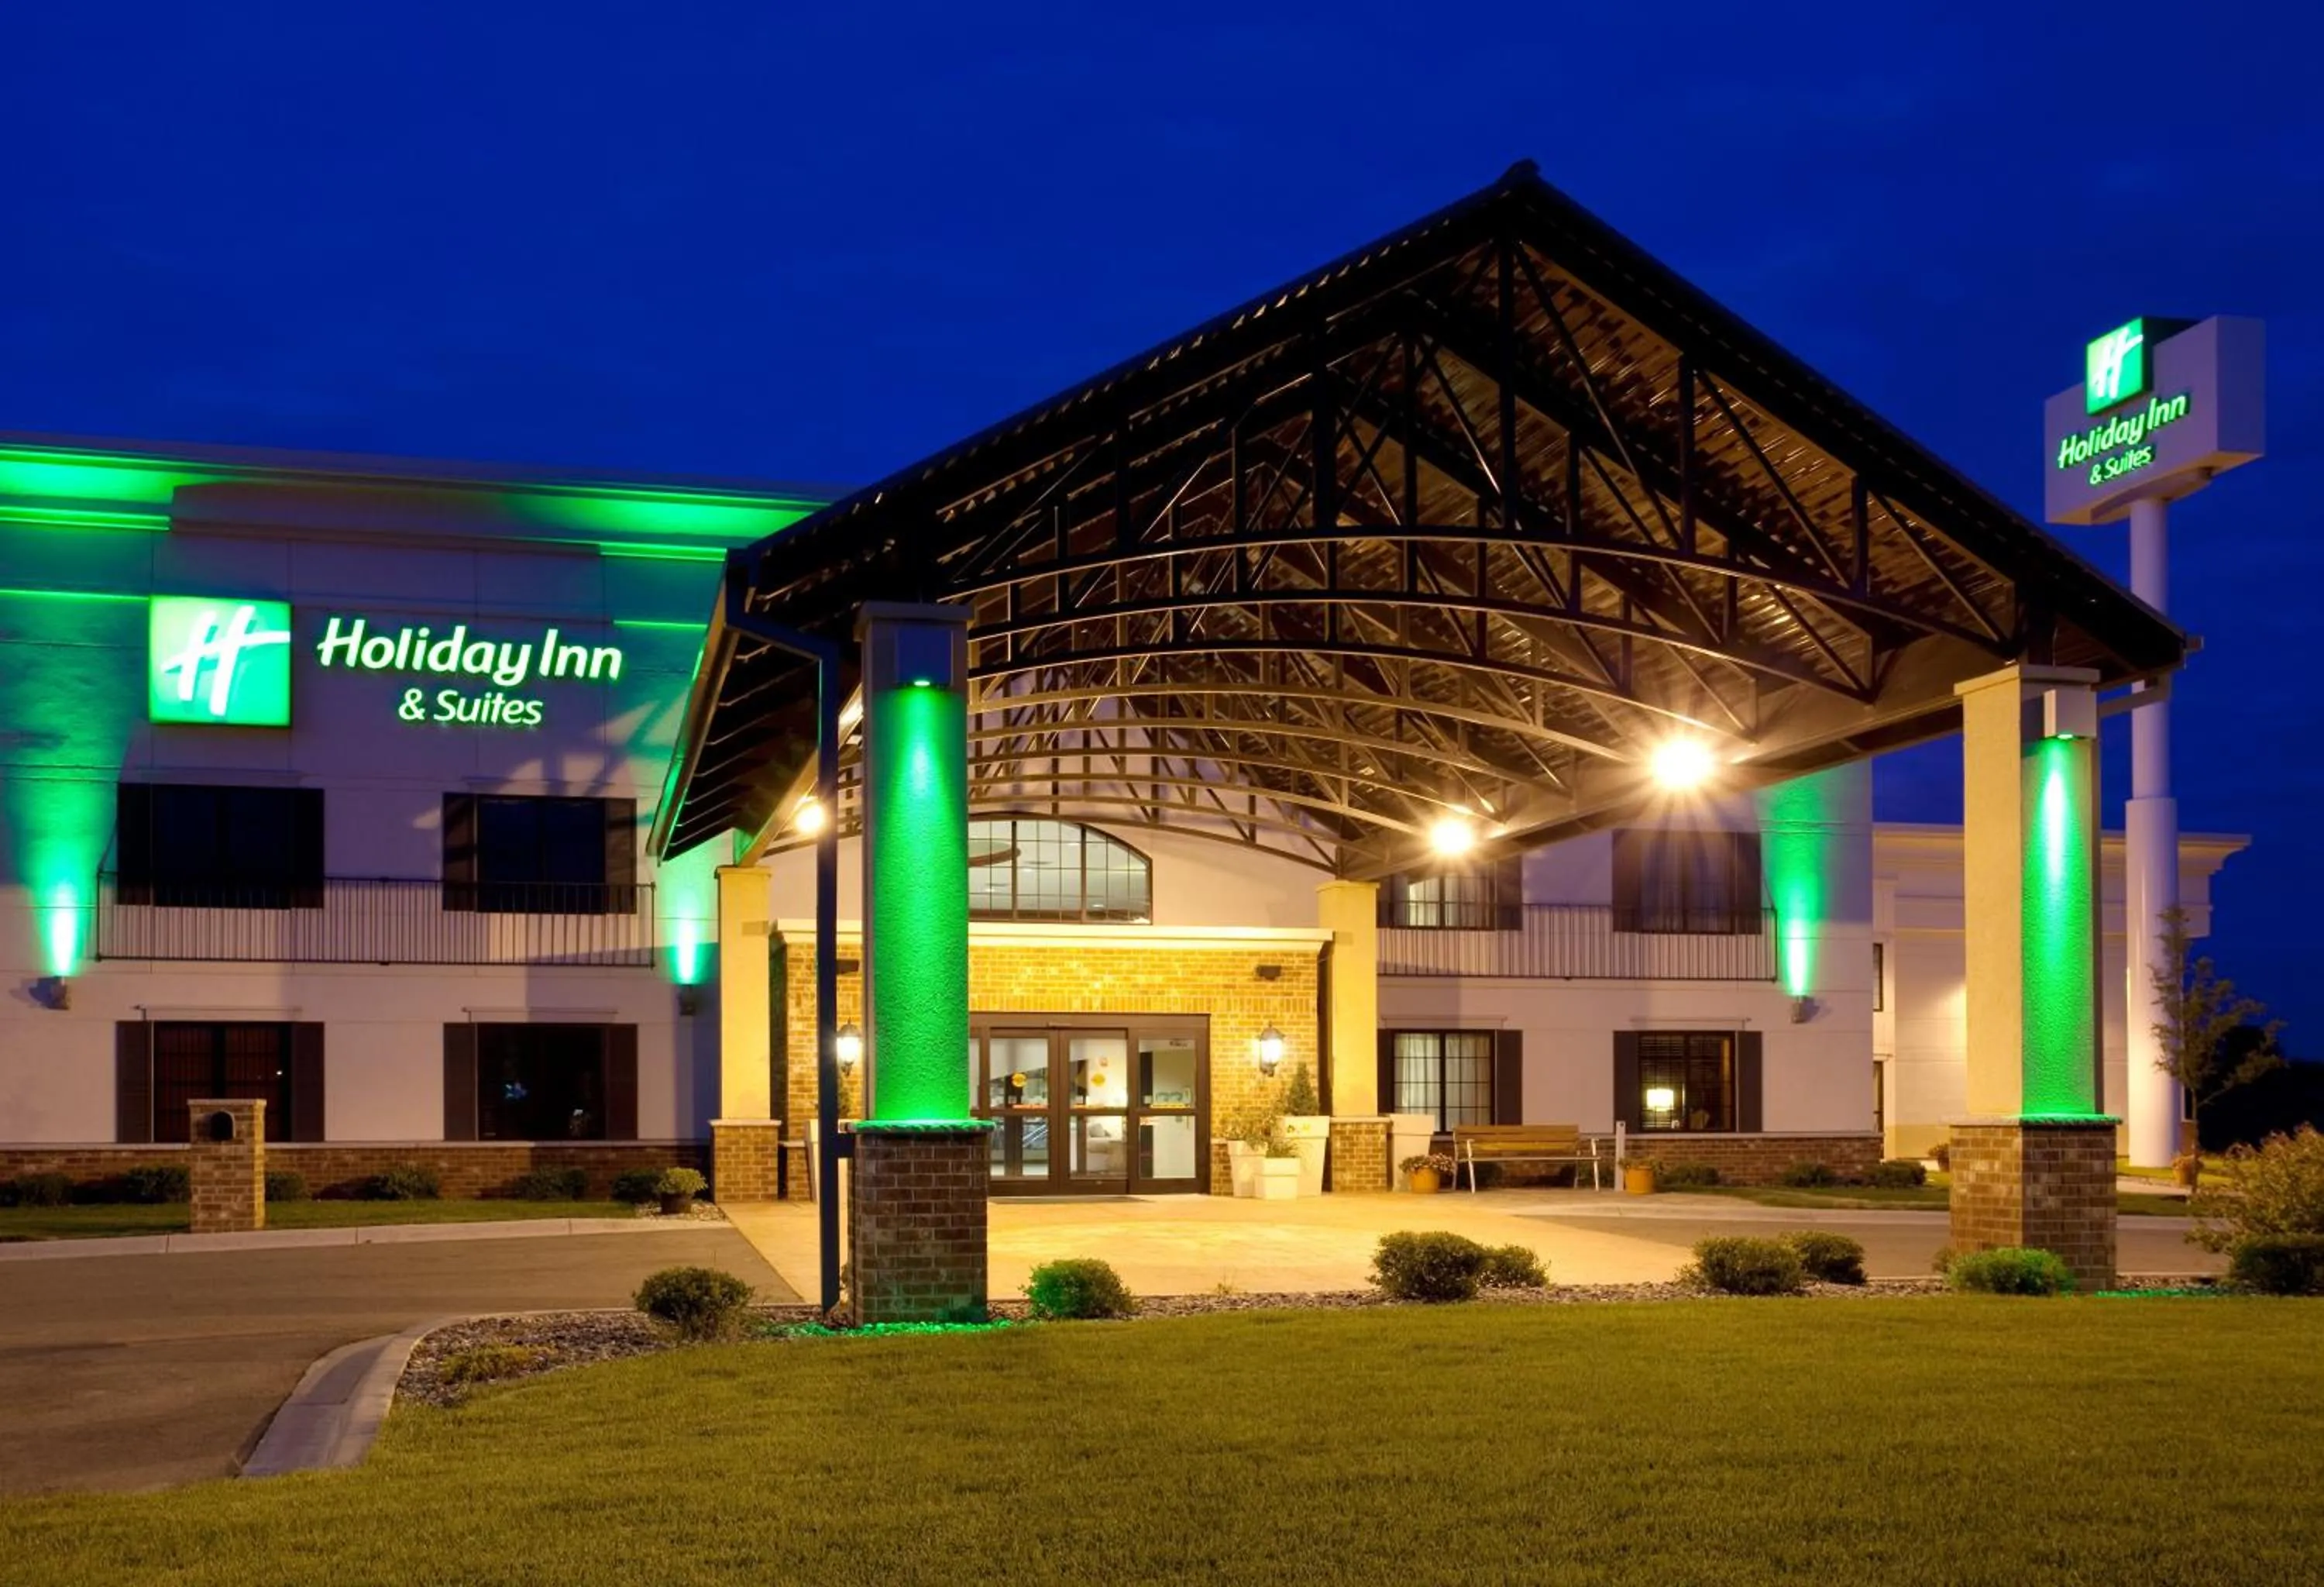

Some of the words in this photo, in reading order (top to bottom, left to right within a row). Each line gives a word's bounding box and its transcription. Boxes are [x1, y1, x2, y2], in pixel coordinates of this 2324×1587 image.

[2058, 414, 2144, 469] Holiday
[2147, 395, 2186, 430] Inn
[2089, 464, 2104, 484] &
[2104, 446, 2151, 480] Suites
[318, 618, 531, 686] Holiday
[540, 628, 622, 680] Inn
[397, 688, 426, 722] &
[433, 689, 544, 725] Suites
